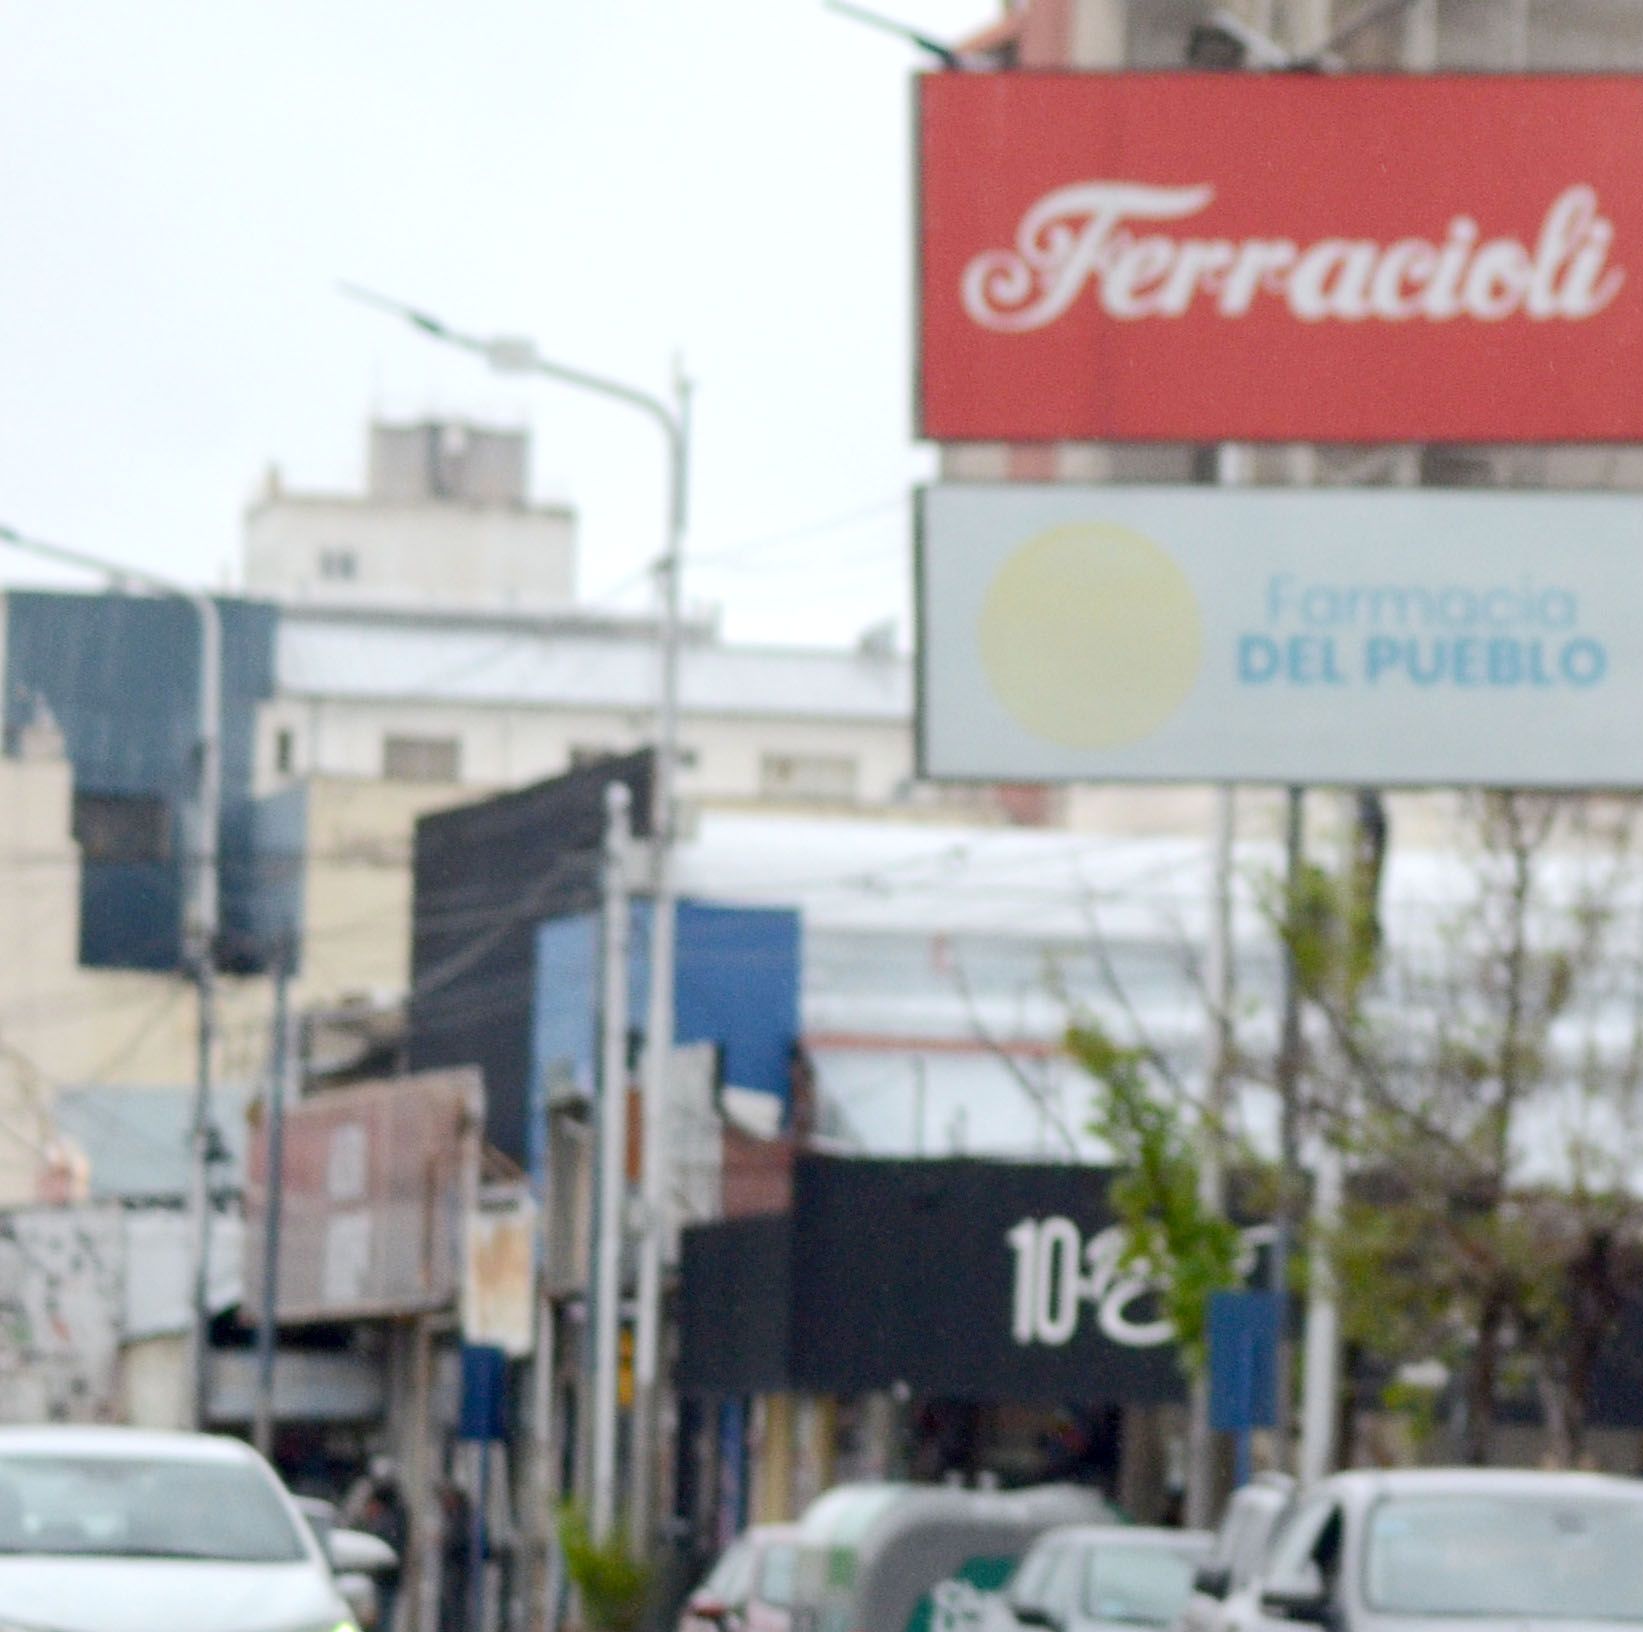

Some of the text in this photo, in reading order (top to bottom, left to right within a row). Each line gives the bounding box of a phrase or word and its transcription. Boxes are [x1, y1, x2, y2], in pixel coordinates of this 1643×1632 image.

[962, 179, 1626, 332] Ferracioli
[1266, 573, 1577, 627] Farmacia
[1238, 635, 1609, 687] DEL PUEBLO
